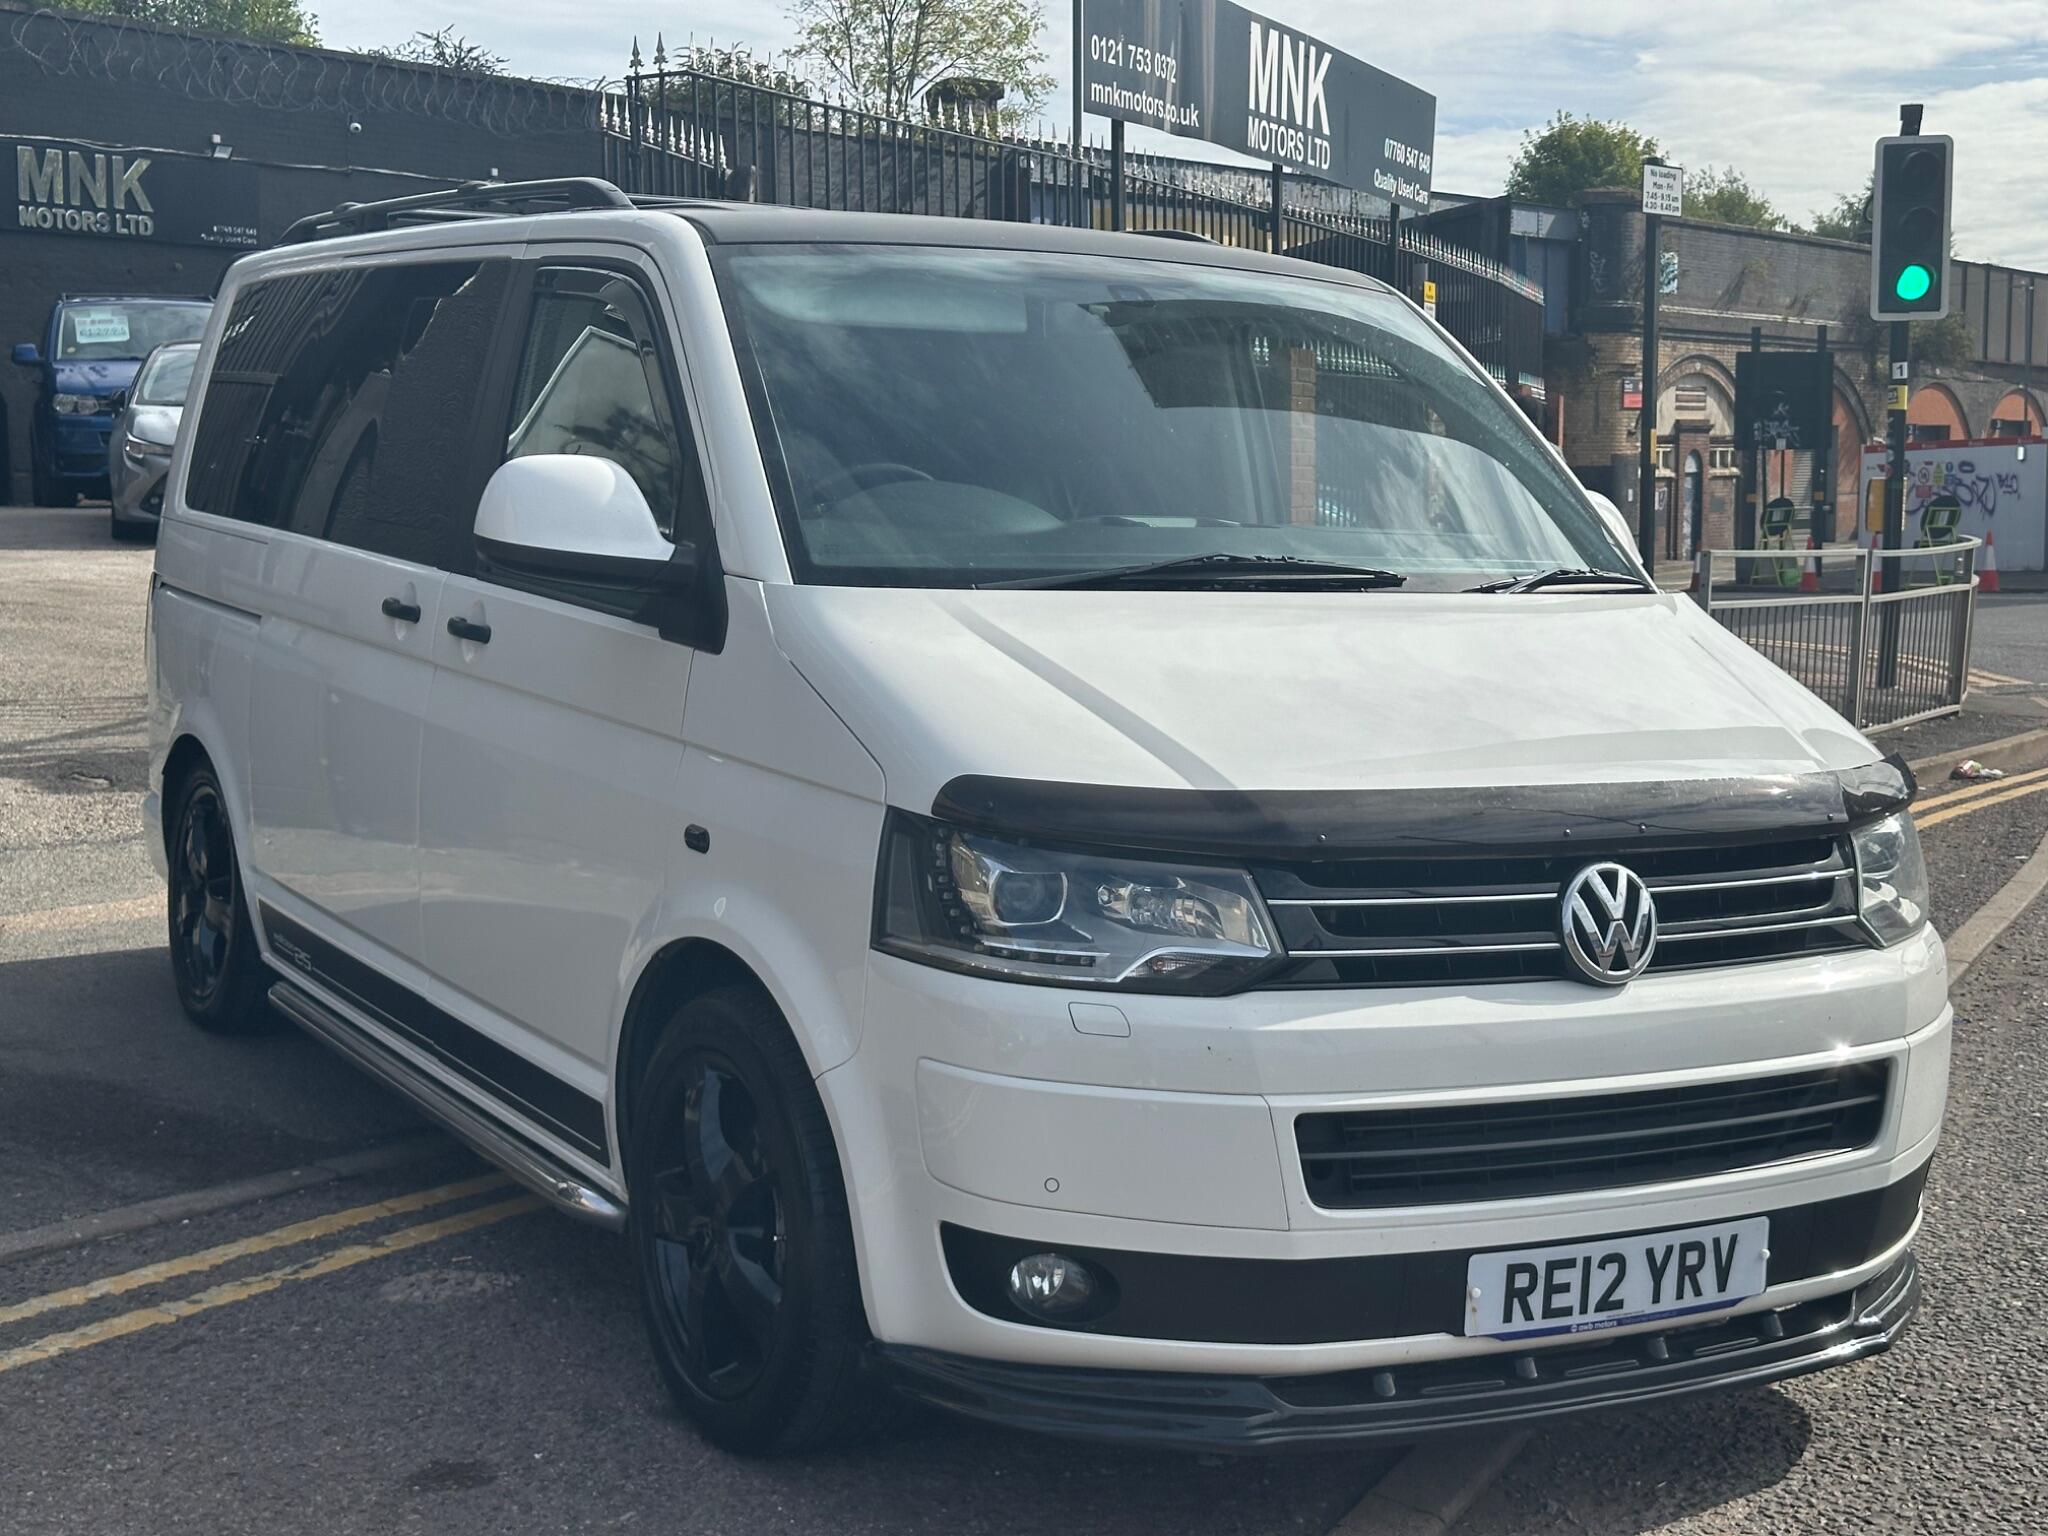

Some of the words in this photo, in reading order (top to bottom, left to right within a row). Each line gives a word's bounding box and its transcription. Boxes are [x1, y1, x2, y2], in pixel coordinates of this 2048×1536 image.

[1091, 34, 1123, 67] 0121
[1128, 44, 1151, 74] 753
[1155, 52, 1177, 83] 0372
[1249, 21, 1333, 136] MNK
[1091, 81, 1199, 127] mnkmotors.co.uk
[1247, 116, 1304, 162] MOTORS
[1307, 135, 1331, 170] LTD
[17, 145, 154, 213] MNK
[1374, 168, 1397, 198] Quality
[1398, 177, 1415, 200] Used
[1415, 183, 1429, 205] Cars
[18, 205, 111, 233] MOTORS
[116, 213, 154, 236] LTD
[1896, 364, 1903, 377] 1
[1502, 1252, 1627, 1324] RE12
[1645, 1233, 1739, 1305] YRV
